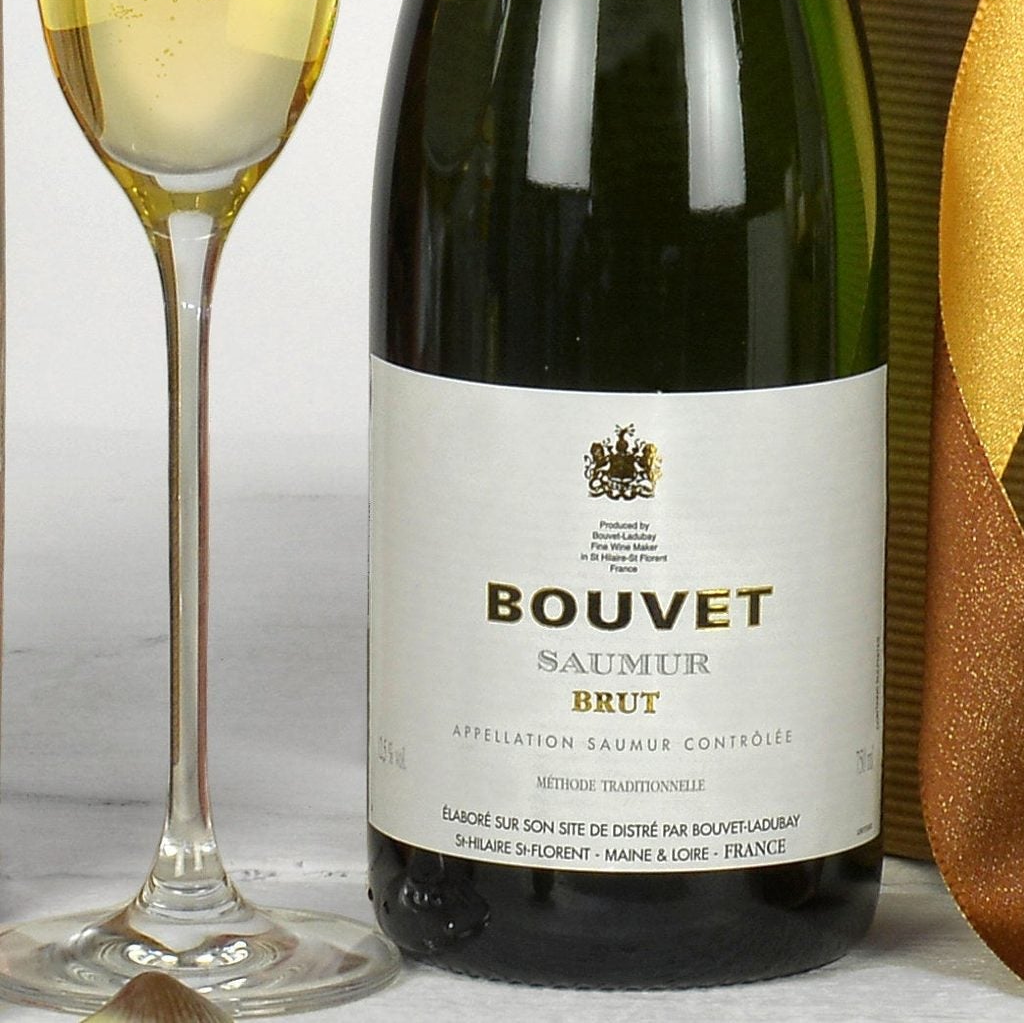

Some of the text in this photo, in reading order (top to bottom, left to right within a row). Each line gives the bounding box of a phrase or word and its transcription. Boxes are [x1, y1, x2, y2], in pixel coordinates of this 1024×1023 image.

[599, 520, 651, 531] Produced by
[591, 542, 658, 551] Fine Wine Maker
[592, 531, 657, 542] Bouvet-Ladubay
[580, 553, 588, 561] in
[590, 553, 600, 562] St
[639, 553, 668, 562] Florent
[610, 563, 638, 573] France
[486, 581, 774, 631] BOUVET
[537, 649, 711, 676] SAUMUR
[571, 689, 660, 714] BRUT
[452, 724, 793, 752] APPELLATION SAUMUR CONTRÔLÉE
[537, 774, 706, 793] MÉTHODE TRADITIONNELLE
[442, 804, 801, 838] ÉLABORÉ SUR SON SITE DE DISTRÉ PAR BOUVET-LADUBAY
[515, 842, 591, 861] St-FLORENT
[605, 848, 652, 862] MAINE
[657, 848, 667, 862] &
[672, 847, 709, 861] LOIRE
[724, 838, 786, 859] FRANCE
